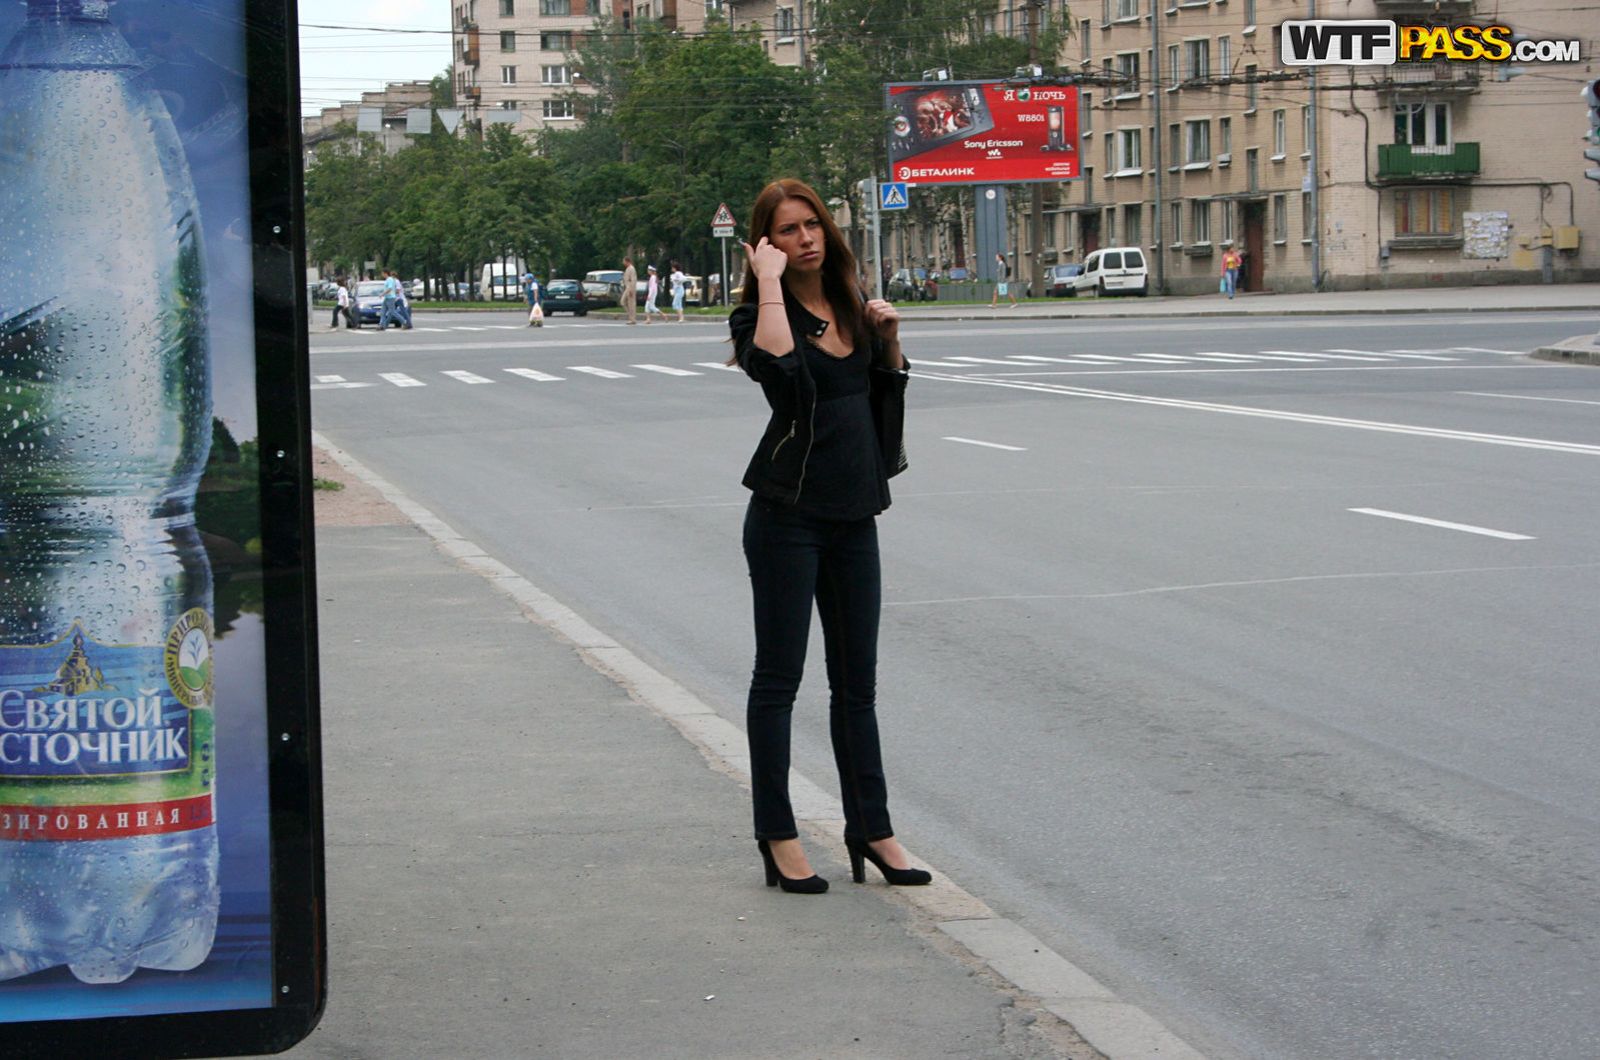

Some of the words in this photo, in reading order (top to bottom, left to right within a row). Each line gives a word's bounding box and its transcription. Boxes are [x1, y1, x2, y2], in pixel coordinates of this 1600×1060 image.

[1004, 90, 1015, 101] Я
[1033, 91, 1066, 101] НОЧЬ
[964, 140, 986, 149] Sony
[987, 139, 1023, 148] Ericsson
[911, 167, 975, 177] БЕТАЛИНК
[0, 688, 161, 730] СВЯТОЙ
[2, 808, 180, 830] ЗИРОВАННАЯ
